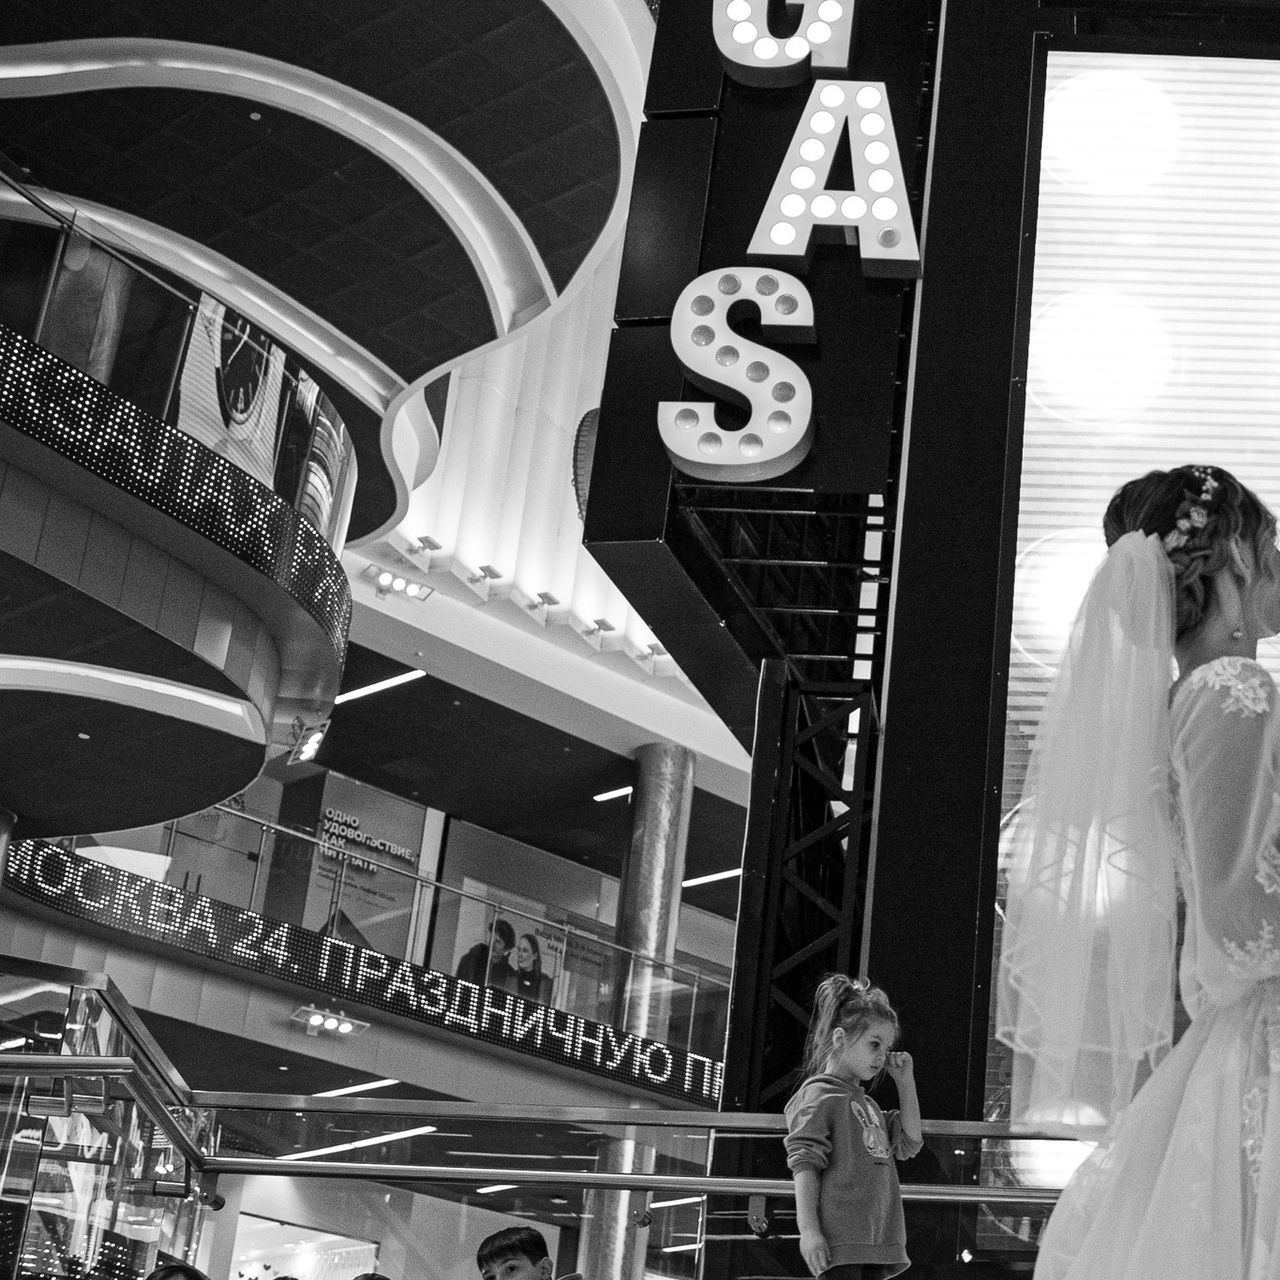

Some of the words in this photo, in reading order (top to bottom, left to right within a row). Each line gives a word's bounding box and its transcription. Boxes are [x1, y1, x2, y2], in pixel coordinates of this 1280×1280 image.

[0, 331, 281, 561] КЗАЛАХ
[321, 831, 346, 849] КАК
[325, 807, 360, 827] ОДНО
[7, 838, 218, 948] МОСКВА
[317, 935, 673, 1084] ПРАЗДНИЧНУЮ
